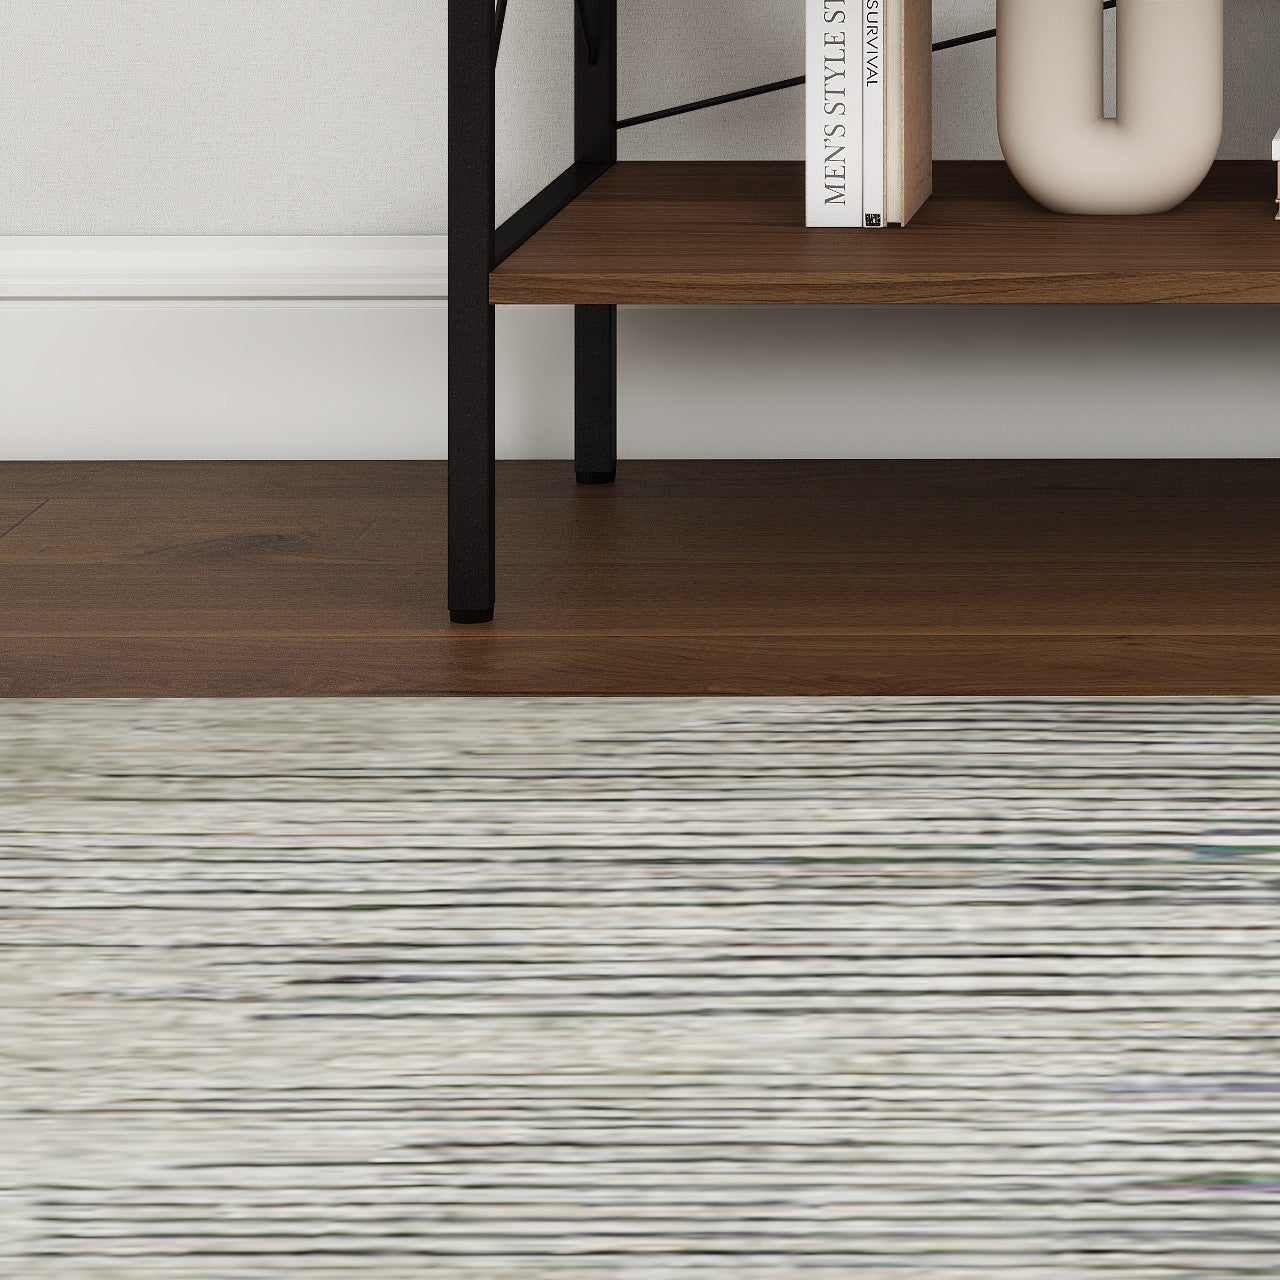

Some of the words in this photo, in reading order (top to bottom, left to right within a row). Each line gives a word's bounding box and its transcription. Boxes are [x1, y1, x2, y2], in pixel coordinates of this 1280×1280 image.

[823, 31, 846, 116] STYLE
[866, 0, 879, 88] SURVIVAL
[823, 124, 846, 206] MEN'S
